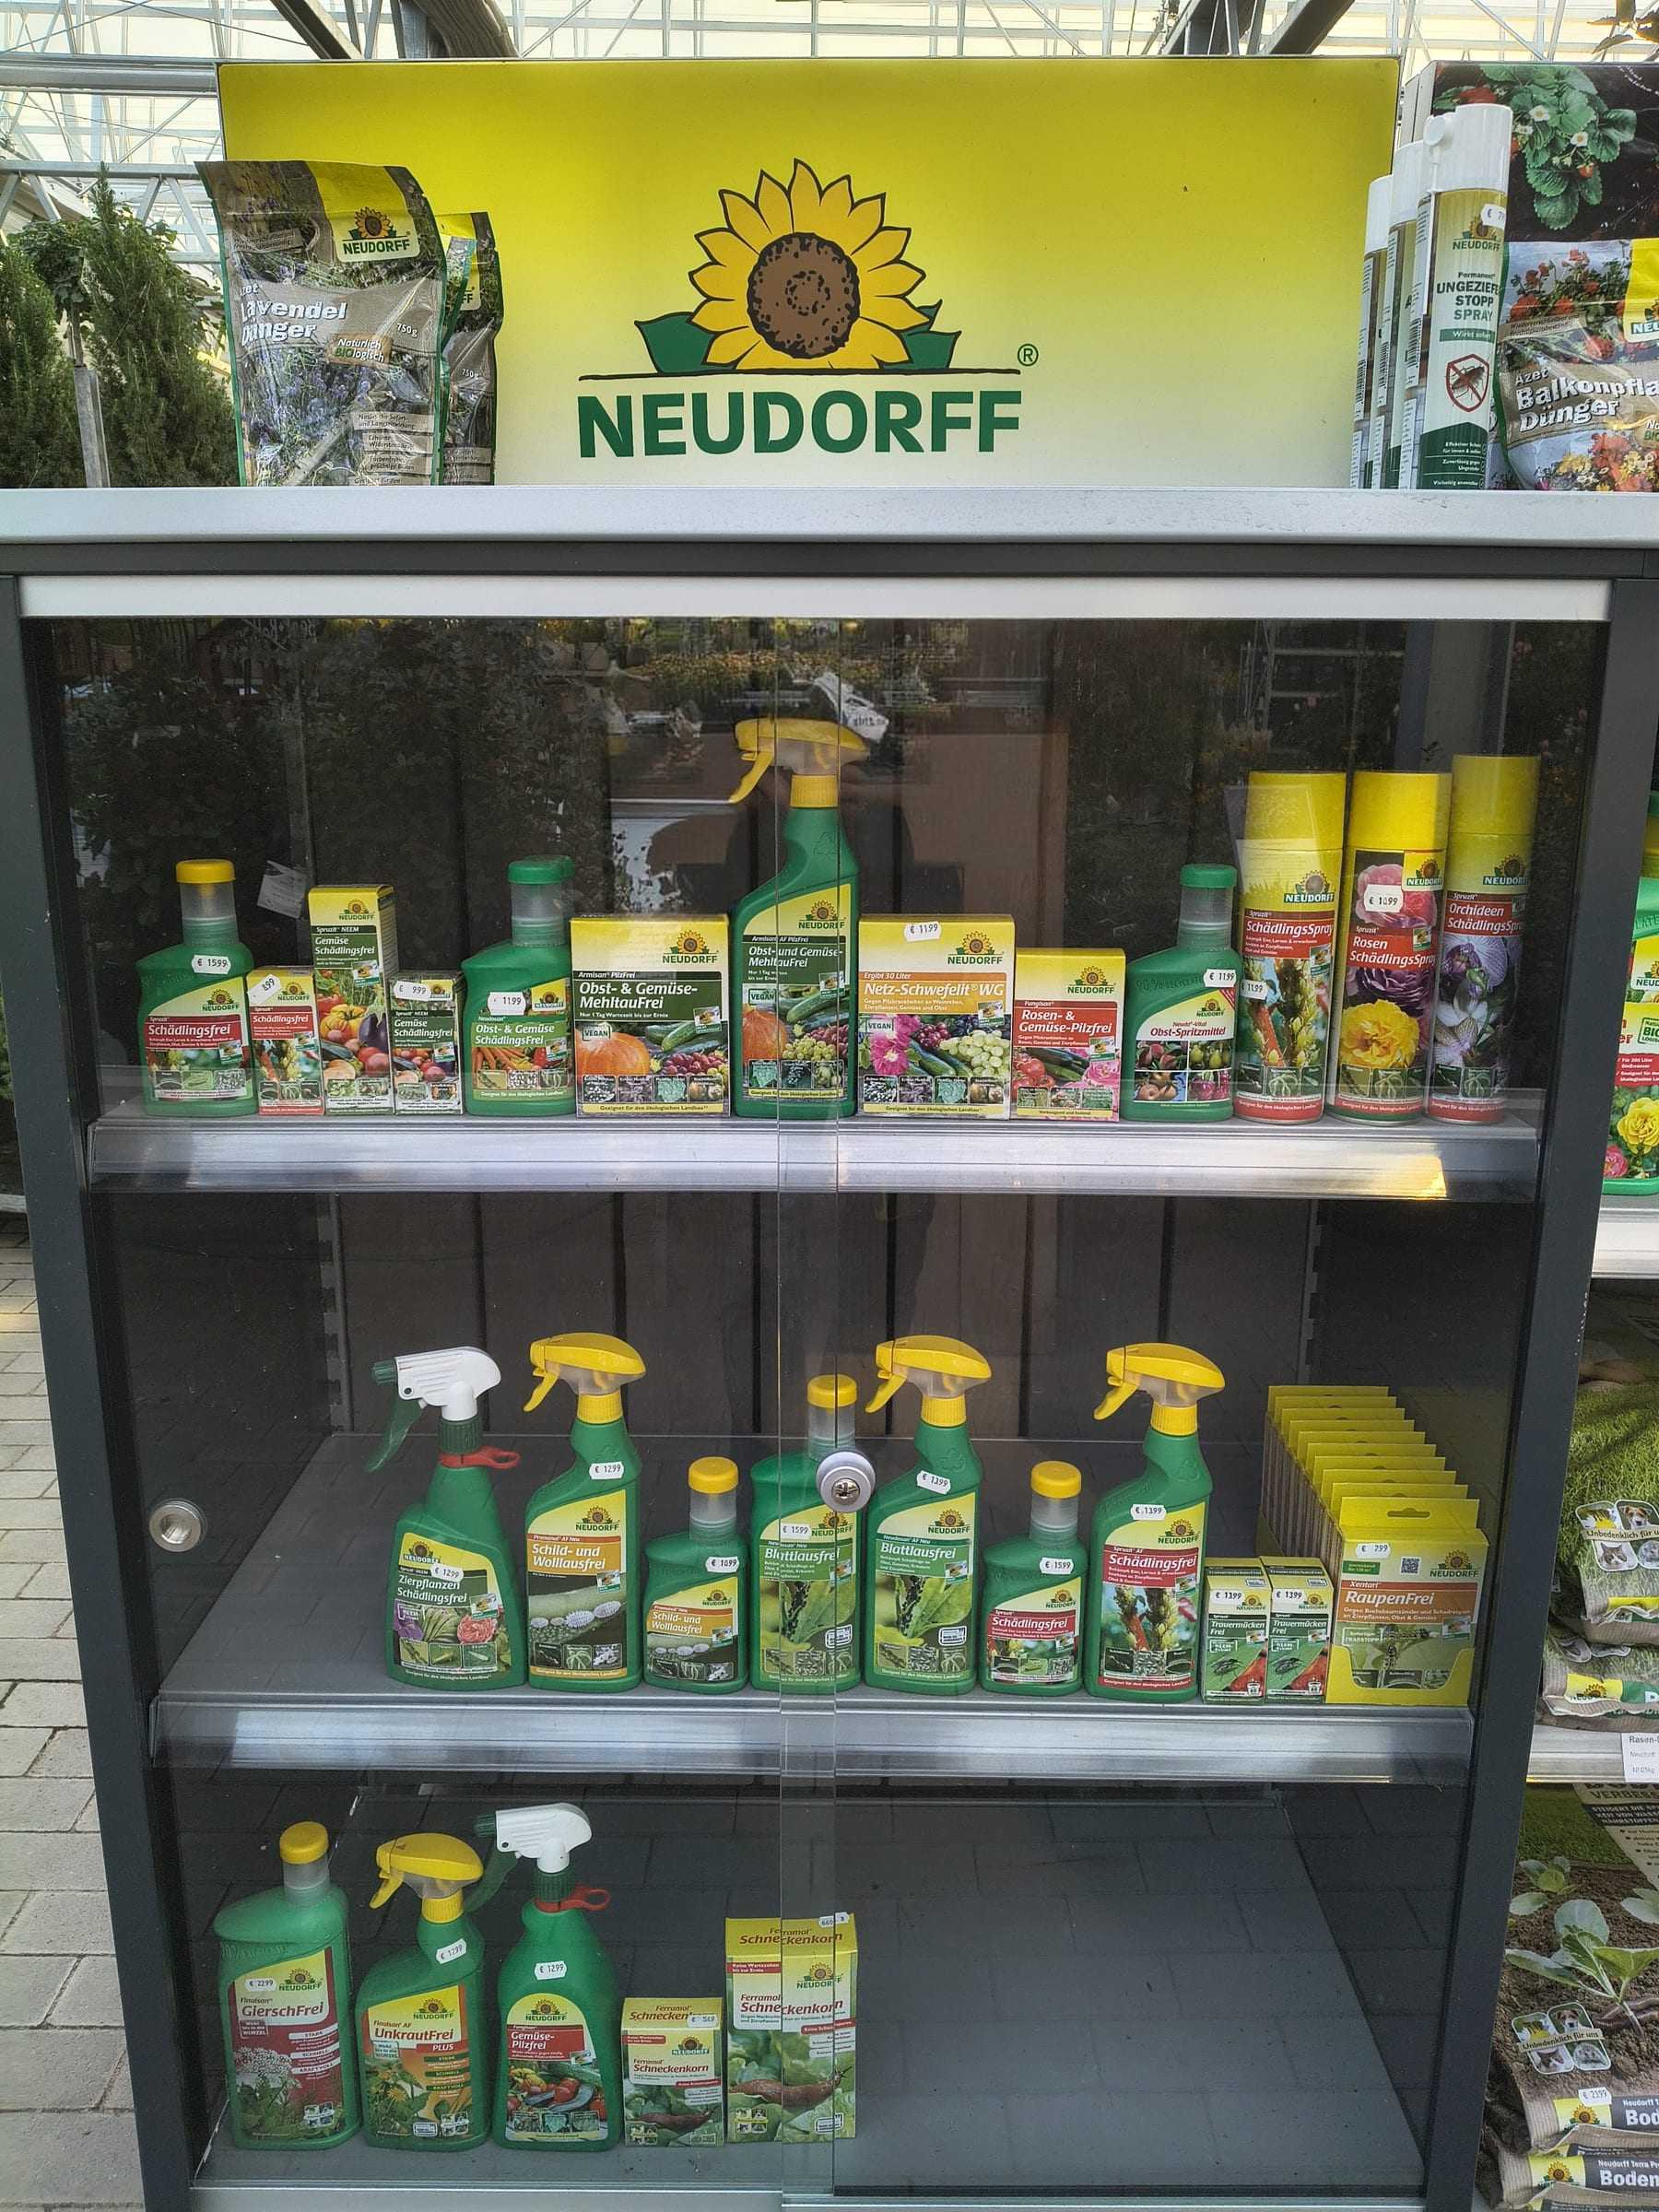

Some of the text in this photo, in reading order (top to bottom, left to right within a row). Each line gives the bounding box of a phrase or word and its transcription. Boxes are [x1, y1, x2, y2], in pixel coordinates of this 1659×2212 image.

[343, 239, 411, 256] NEUDORFF
[1453, 241, 1500, 252] NEUDORFF
[1455, 295, 1494, 308] STOPP
[1453, 309, 1494, 323] SPRAY
[396, 323, 418, 338] 750g
[337, 337, 382, 350] Natürlich
[335, 347, 384, 363] BIOlogisch
[1514, 369, 1548, 386] Azet
[1519, 398, 1620, 433] Dünger
[578, 390, 1022, 459] NEUDORFF
[1285, 893, 1335, 903] NEUDORFF
[1369, 898, 1374, 906] €
[1449, 902, 1504, 917] Orchideen
[798, 921, 845, 930] NEUDORFF
[909, 922, 939, 935] € 1199
[1246, 921, 1334, 937] SchädlingsSpray
[314, 935, 349, 946] Gemüse
[1353, 935, 1388, 949] Rosen
[314, 945, 375, 957] Schädlingsfrei
[748, 946, 843, 957] Obst- und Gemüse-
[207, 958, 228, 968] 1599
[663, 954, 718, 964] NEUDORFF
[748, 957, 808, 968] MehltauFrei
[947, 955, 1004, 965] NEUDORFF
[611, 971, 636, 979] PilzFrei
[864, 971, 912, 981] Ergibt 30 Liter
[1218, 972, 1235, 982] 1199
[411, 985, 427, 995] 999
[579, 981, 698, 995] Obst- & Gemüse-
[864, 982, 1004, 997] Netz-Schwefelit WG
[1067, 985, 1115, 994] NEUDORFF
[750, 992, 774, 1001] VEGAN
[202, 1004, 240, 1012] NEUDORFF
[579, 996, 664, 1009] MehltauFrei
[253, 1014, 309, 1025] Schädlingsfrei
[1021, 1010, 1076, 1021] Rosen- &
[394, 1018, 428, 1029] Gemüse
[476, 1023, 555, 1034] Obst- & Gemüse
[867, 1022, 892, 1030] VEGAN
[1019, 1021, 1112, 1035] Gemüse-Pilzfrei
[148, 1023, 230, 1039] Schädlingsfrei
[394, 1027, 453, 1039] Schädlingsfrei
[583, 1030, 608, 1039] VEGAN
[1150, 1027, 1226, 1038] Obst-Spritzmittel
[475, 1035, 544, 1047] SchädlingsFrei
[594, 1464, 622, 1474] € 1299
[931, 1476, 948, 1488] 1399
[1135, 1505, 1162, 1515] € 1399
[575, 1524, 619, 1532] NEUDORFF
[791, 1526, 809, 1535] 1599
[811, 1525, 853, 1537] NEUDORFF
[928, 1525, 971, 1535] NEUDORFF
[1158, 1536, 1199, 1545] NEUDORFF
[1586, 1530, 1653, 1540] Unbedenklich für
[532, 1544, 601, 1557] Schild- und
[764, 1547, 841, 1565] Blattlausfrei
[880, 1542, 957, 1560] Blattlausfrei
[533, 1557, 606, 1571] Wolllausfrei
[711, 1559, 717, 1567] €
[1045, 1560, 1071, 1571] € 1599
[1109, 1554, 1197, 1571] Schädlingsfrei
[442, 1567, 460, 1580] 1299
[1430, 1570, 1480, 1578] NEUDORFF
[397, 1574, 461, 1590] Zierpflanzen
[397, 1587, 467, 1605] Schädlingsfrei
[1276, 1591, 1302, 1600] € 1399
[1345, 1590, 1435, 1607] RaupenFrei
[1045, 1601, 1077, 1609] NEUDORFF
[652, 1612, 701, 1625] Schild- und
[992, 1617, 1067, 1631] Schädlingsfrei
[1273, 1619, 1327, 1629] Trauermücken
[651, 1620, 702, 1635] Wolllausfrei
[1210, 1620, 1265, 1630] Trauermücken
[1210, 1629, 1225, 1637] Frei
[739, 1932, 843, 1946] Schneckenkorn
[539, 1963, 565, 1974] € 1299
[256, 1979, 274, 1988] 2299
[278, 1983, 322, 1992] NEUDORFF
[740, 1994, 782, 2002] Ferramol
[241, 2001, 324, 2018] GierschFrei
[740, 1999, 843, 2016] Schneckenkorn
[374, 2028, 454, 2041] UnkrautFrei
[511, 2030, 555, 2041] Gemüse-
[512, 2040, 547, 2052] Pilzfrei
[1522, 2033, 1573, 2051] Unbedenklich
[1574, 2031, 1585, 2041] für
[432, 2042, 454, 2052] PLUS
[633, 2058, 662, 2066] Ferramol
[633, 2064, 709, 2074] Schneckenkorn
